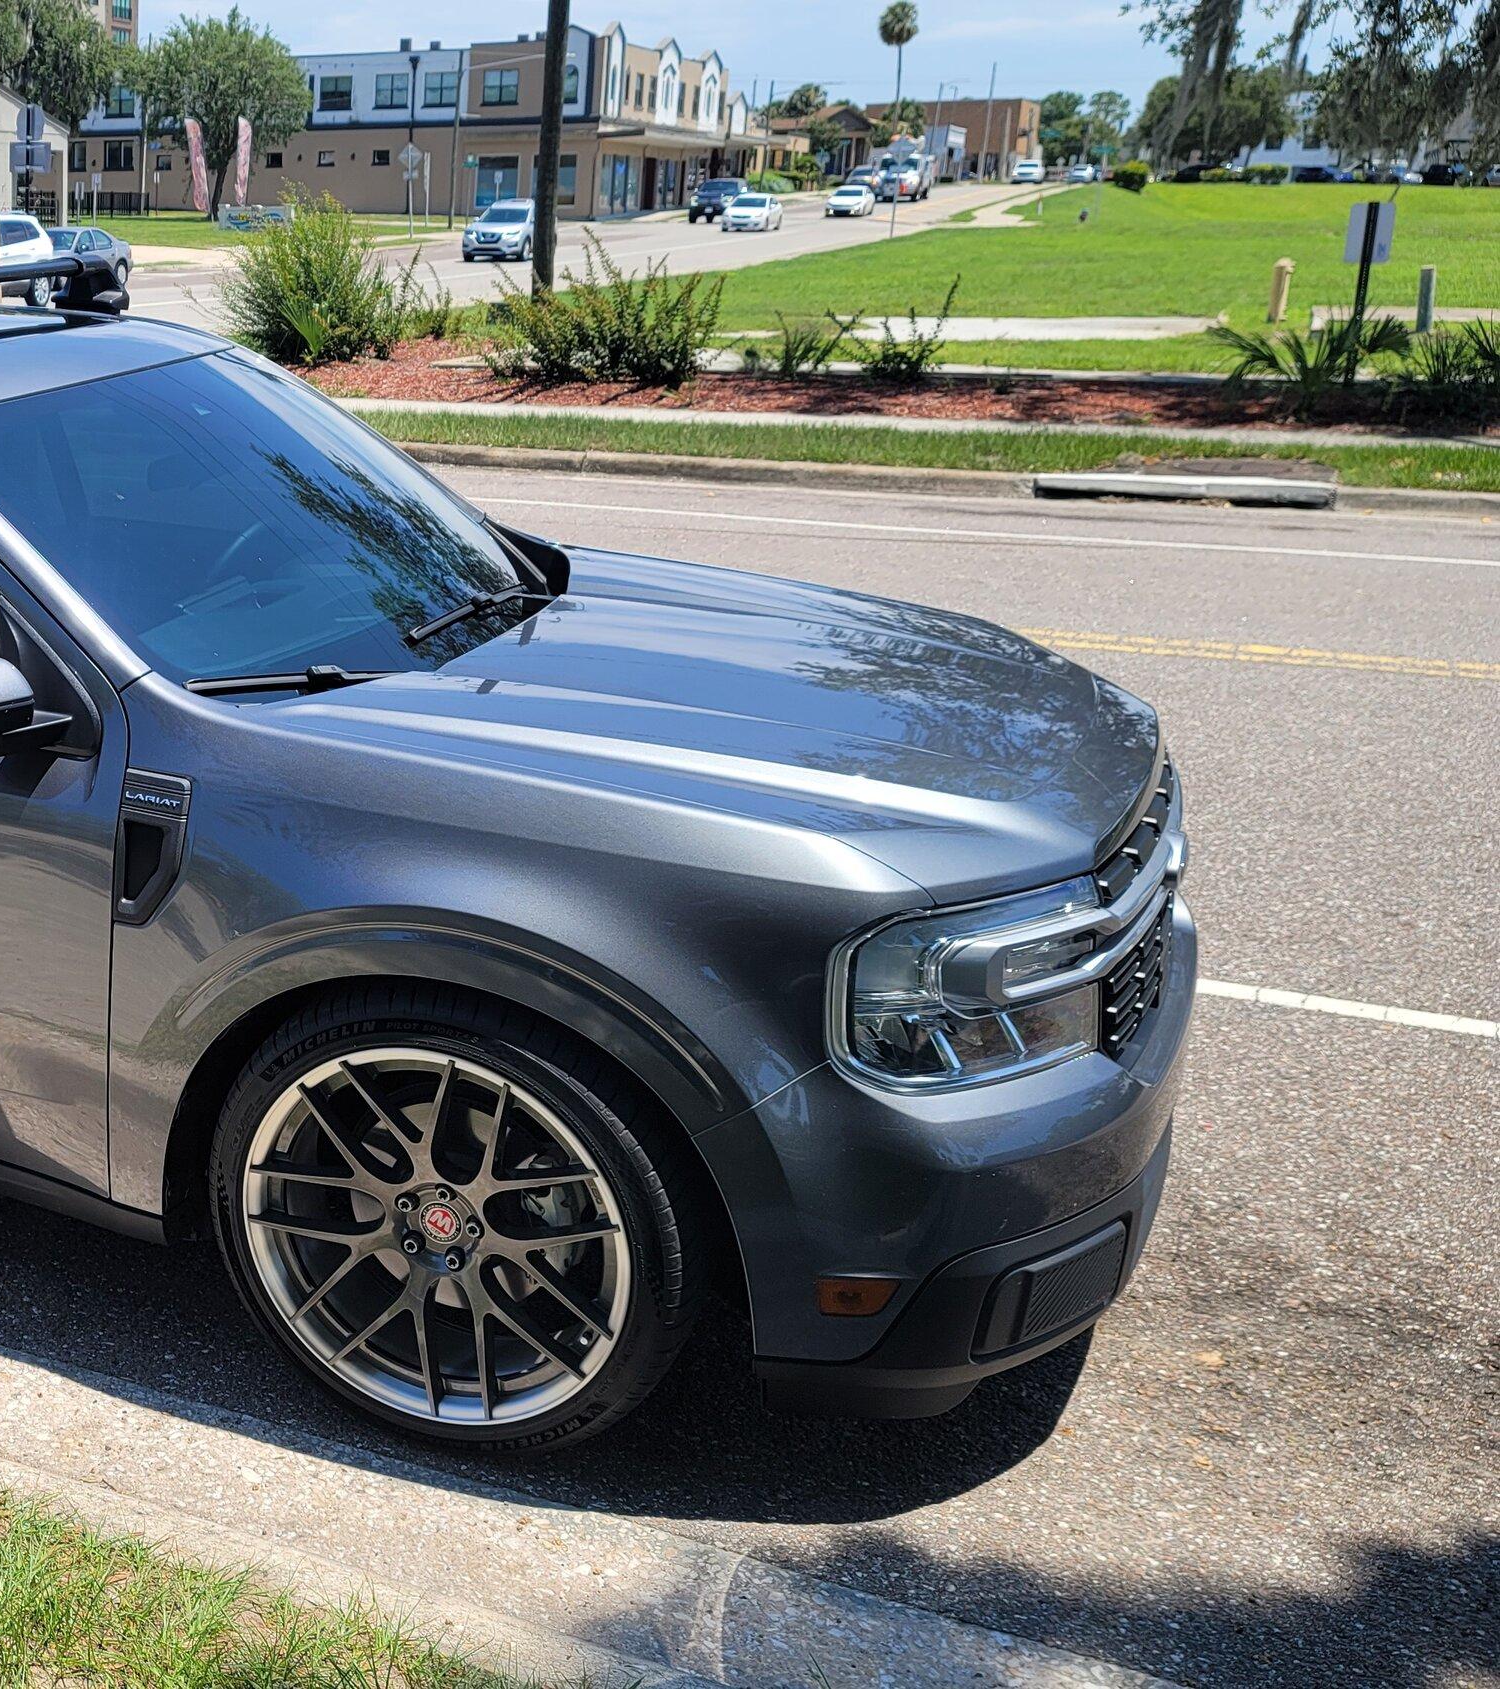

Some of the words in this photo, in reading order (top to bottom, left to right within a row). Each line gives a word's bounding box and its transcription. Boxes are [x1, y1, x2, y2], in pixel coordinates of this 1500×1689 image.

[125, 790, 181, 808] LARIAT
[280, 1020, 377, 1066] MICHELIN
[386, 1021, 419, 1031] PILOT
[422, 1023, 462, 1038] SPORT
